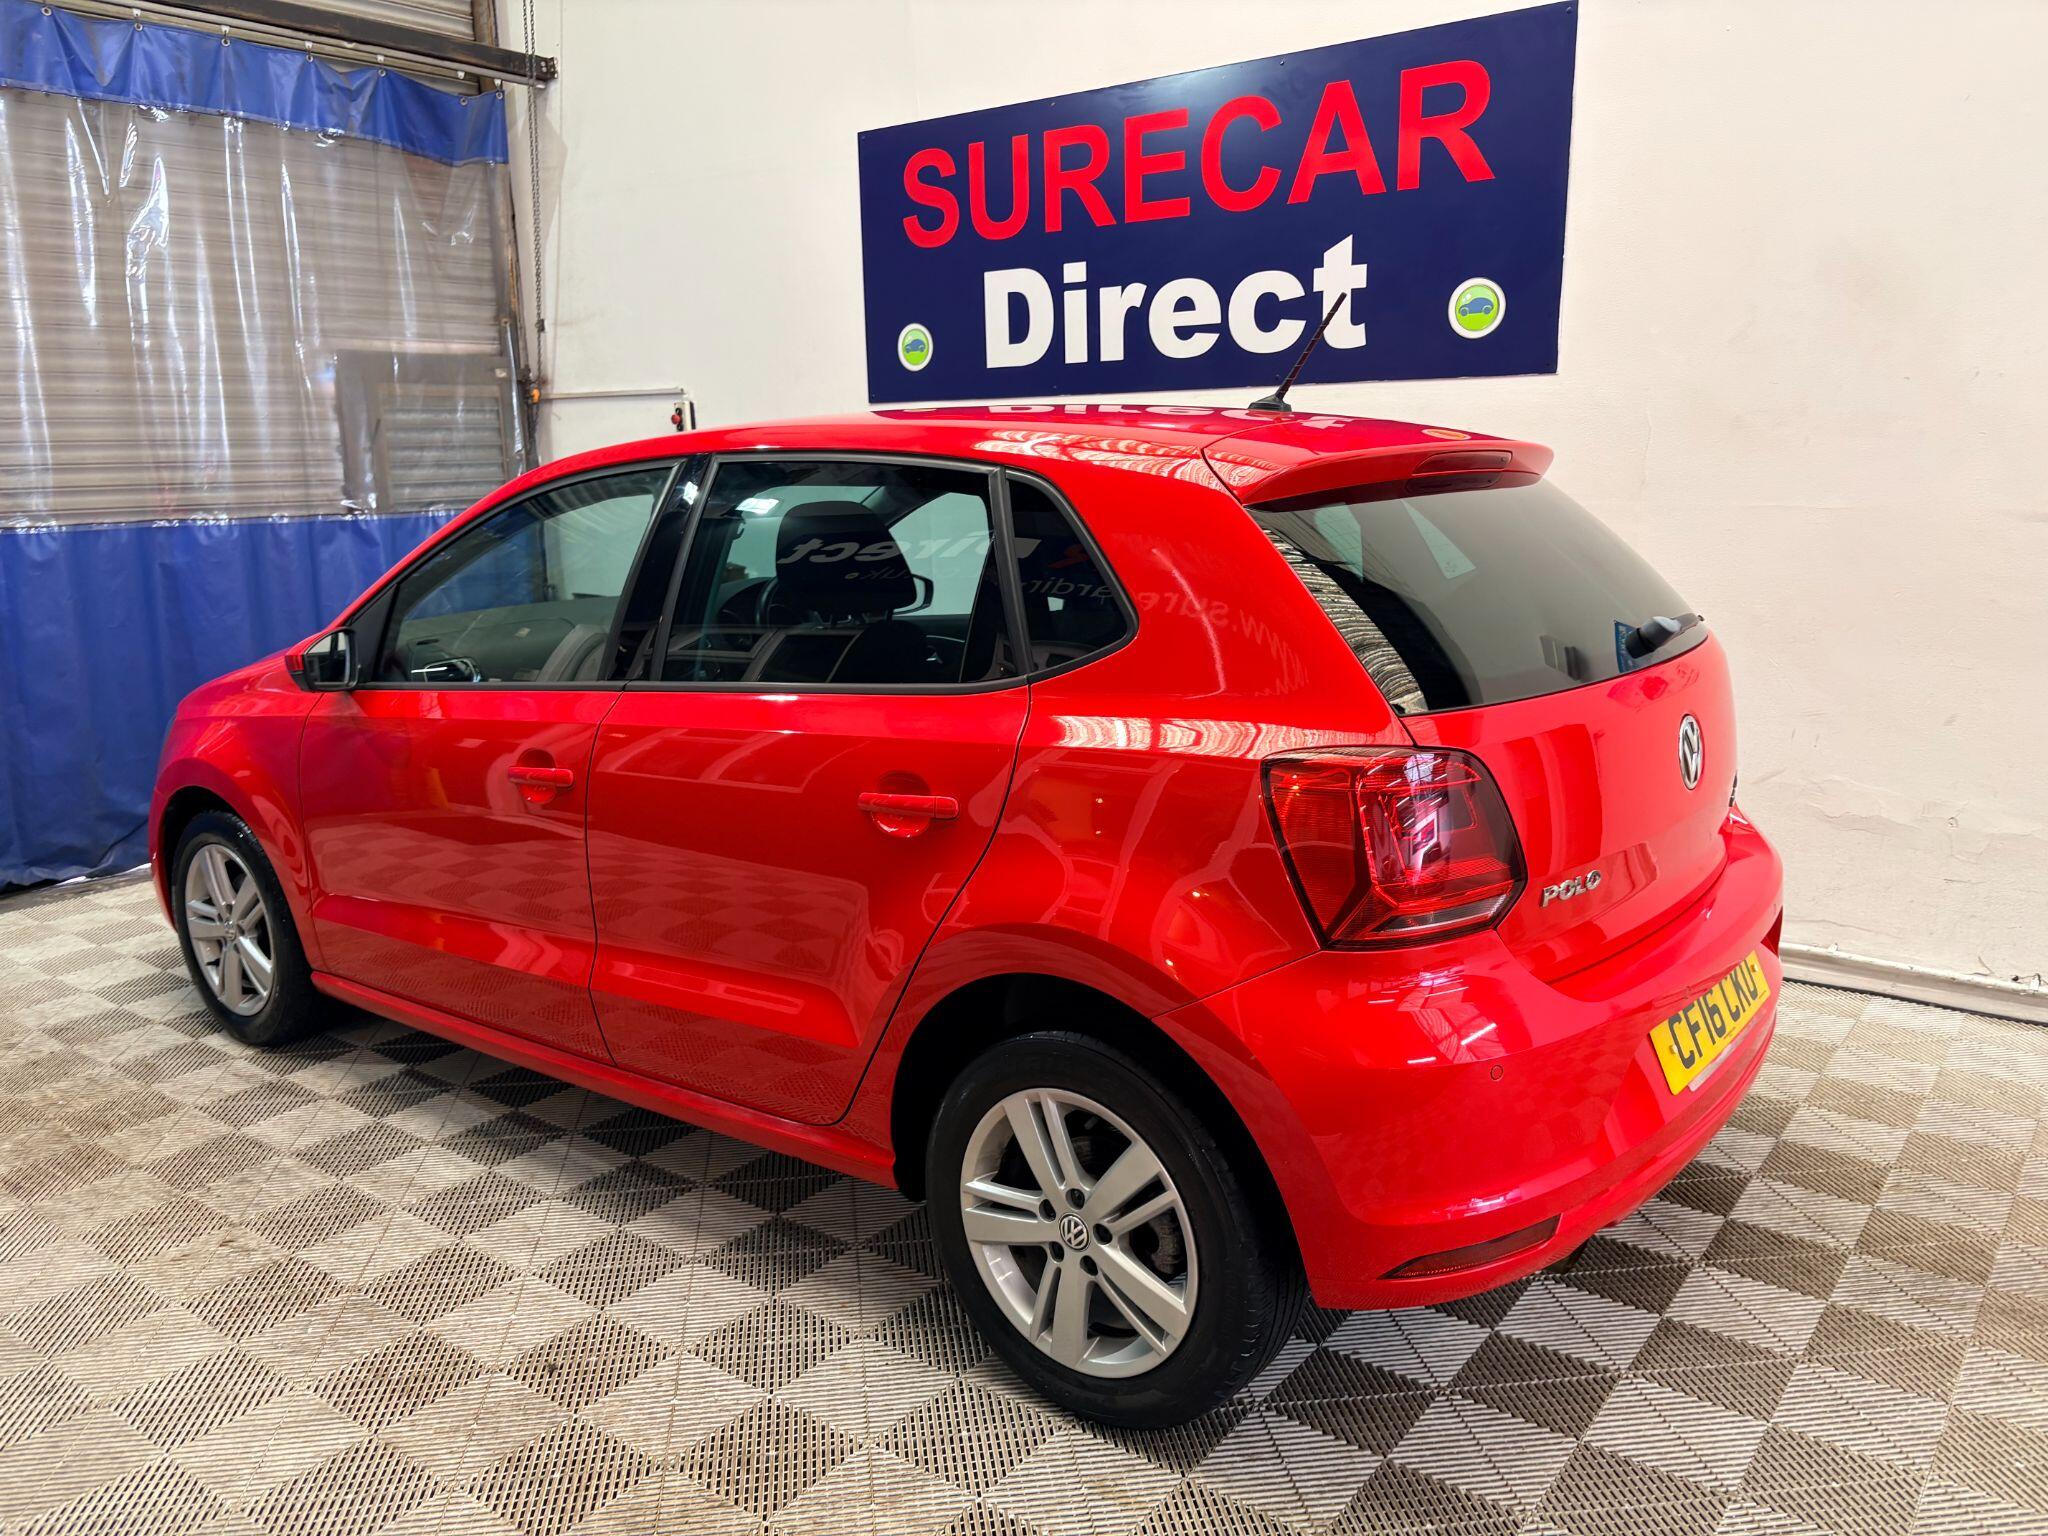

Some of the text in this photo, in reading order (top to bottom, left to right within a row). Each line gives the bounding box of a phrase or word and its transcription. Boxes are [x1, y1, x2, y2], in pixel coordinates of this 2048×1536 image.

[903, 59, 1496, 249] SURECAR
[984, 234, 1368, 369] Direct
[1540, 869, 1602, 908] POLO
[1668, 988, 1727, 1070] CF16
